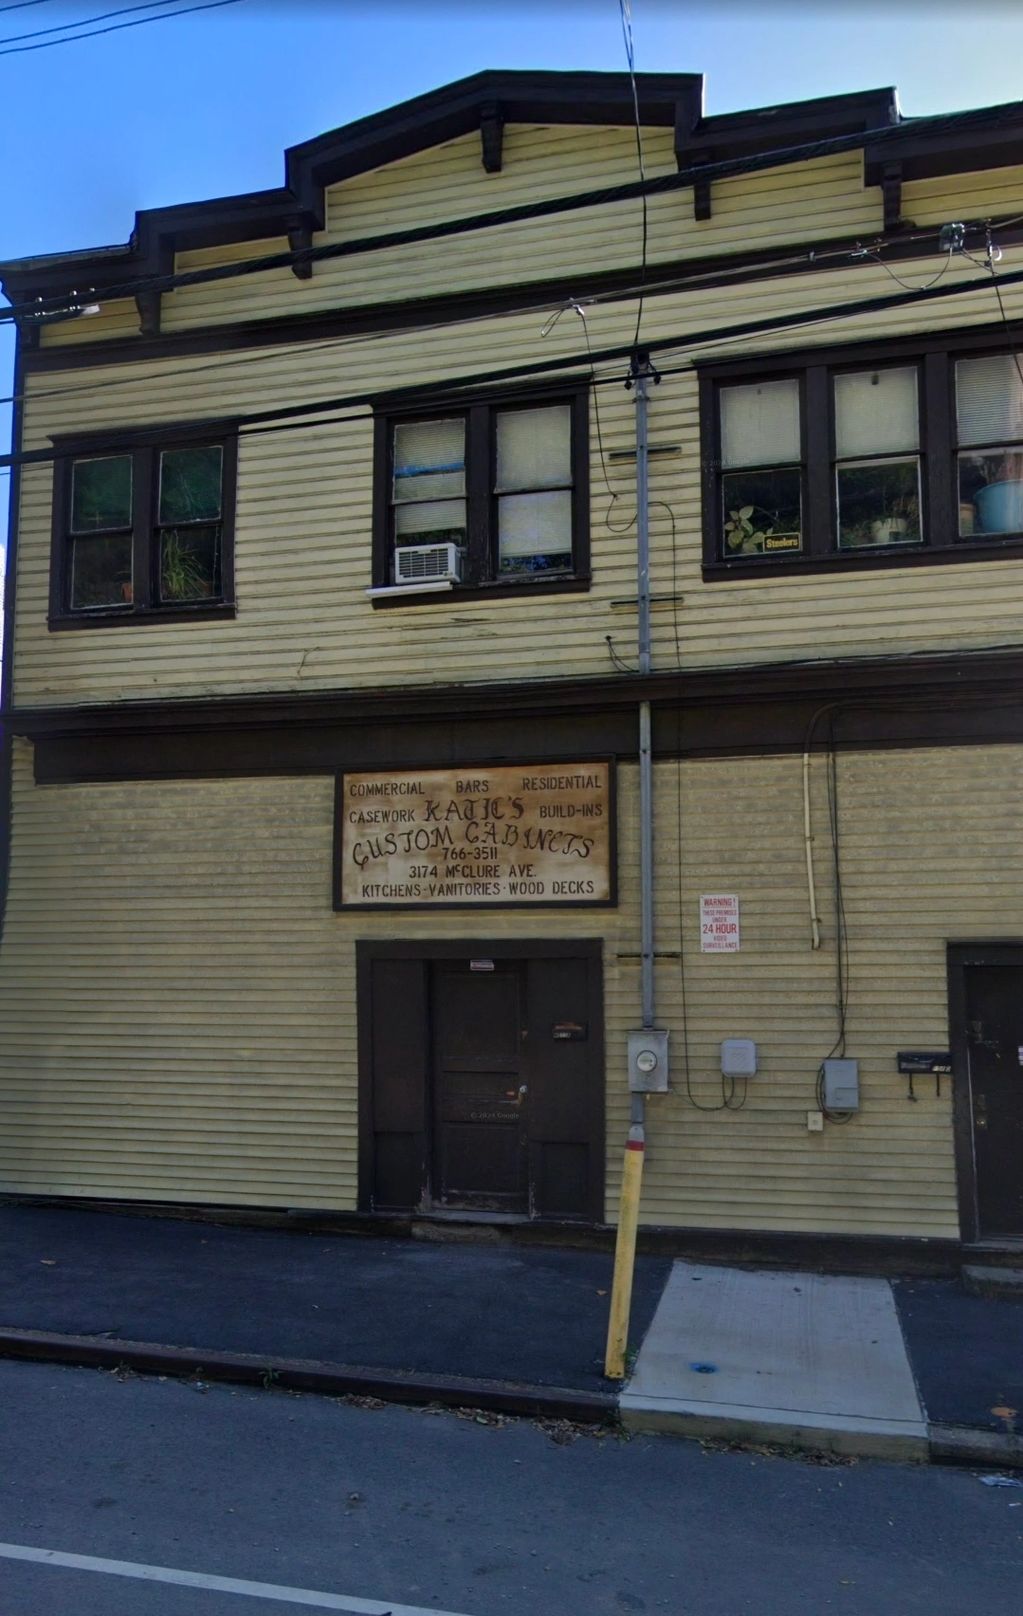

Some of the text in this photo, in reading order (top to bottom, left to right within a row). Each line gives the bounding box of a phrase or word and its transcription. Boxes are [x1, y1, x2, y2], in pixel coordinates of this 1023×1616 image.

[766, 538, 798, 549] Steelers
[350, 782, 425, 797] COMMERCIAL
[456, 780, 489, 793] BARS
[522, 776, 602, 791] RESIDENTIAL
[349, 809, 415, 824] CASEWORK
[539, 804, 603, 818] BUILD-INS
[352, 824, 454, 871] CUSTOM
[442, 847, 498, 860] 766-3511
[409, 865, 438, 878] 3174
[509, 864, 537, 877] AVE.
[362, 884, 421, 897] KITCHENS
[509, 881, 545, 895] WOOD
[552, 880, 594, 894] DECKS
[702, 923, 737, 934] 24 HOUR
